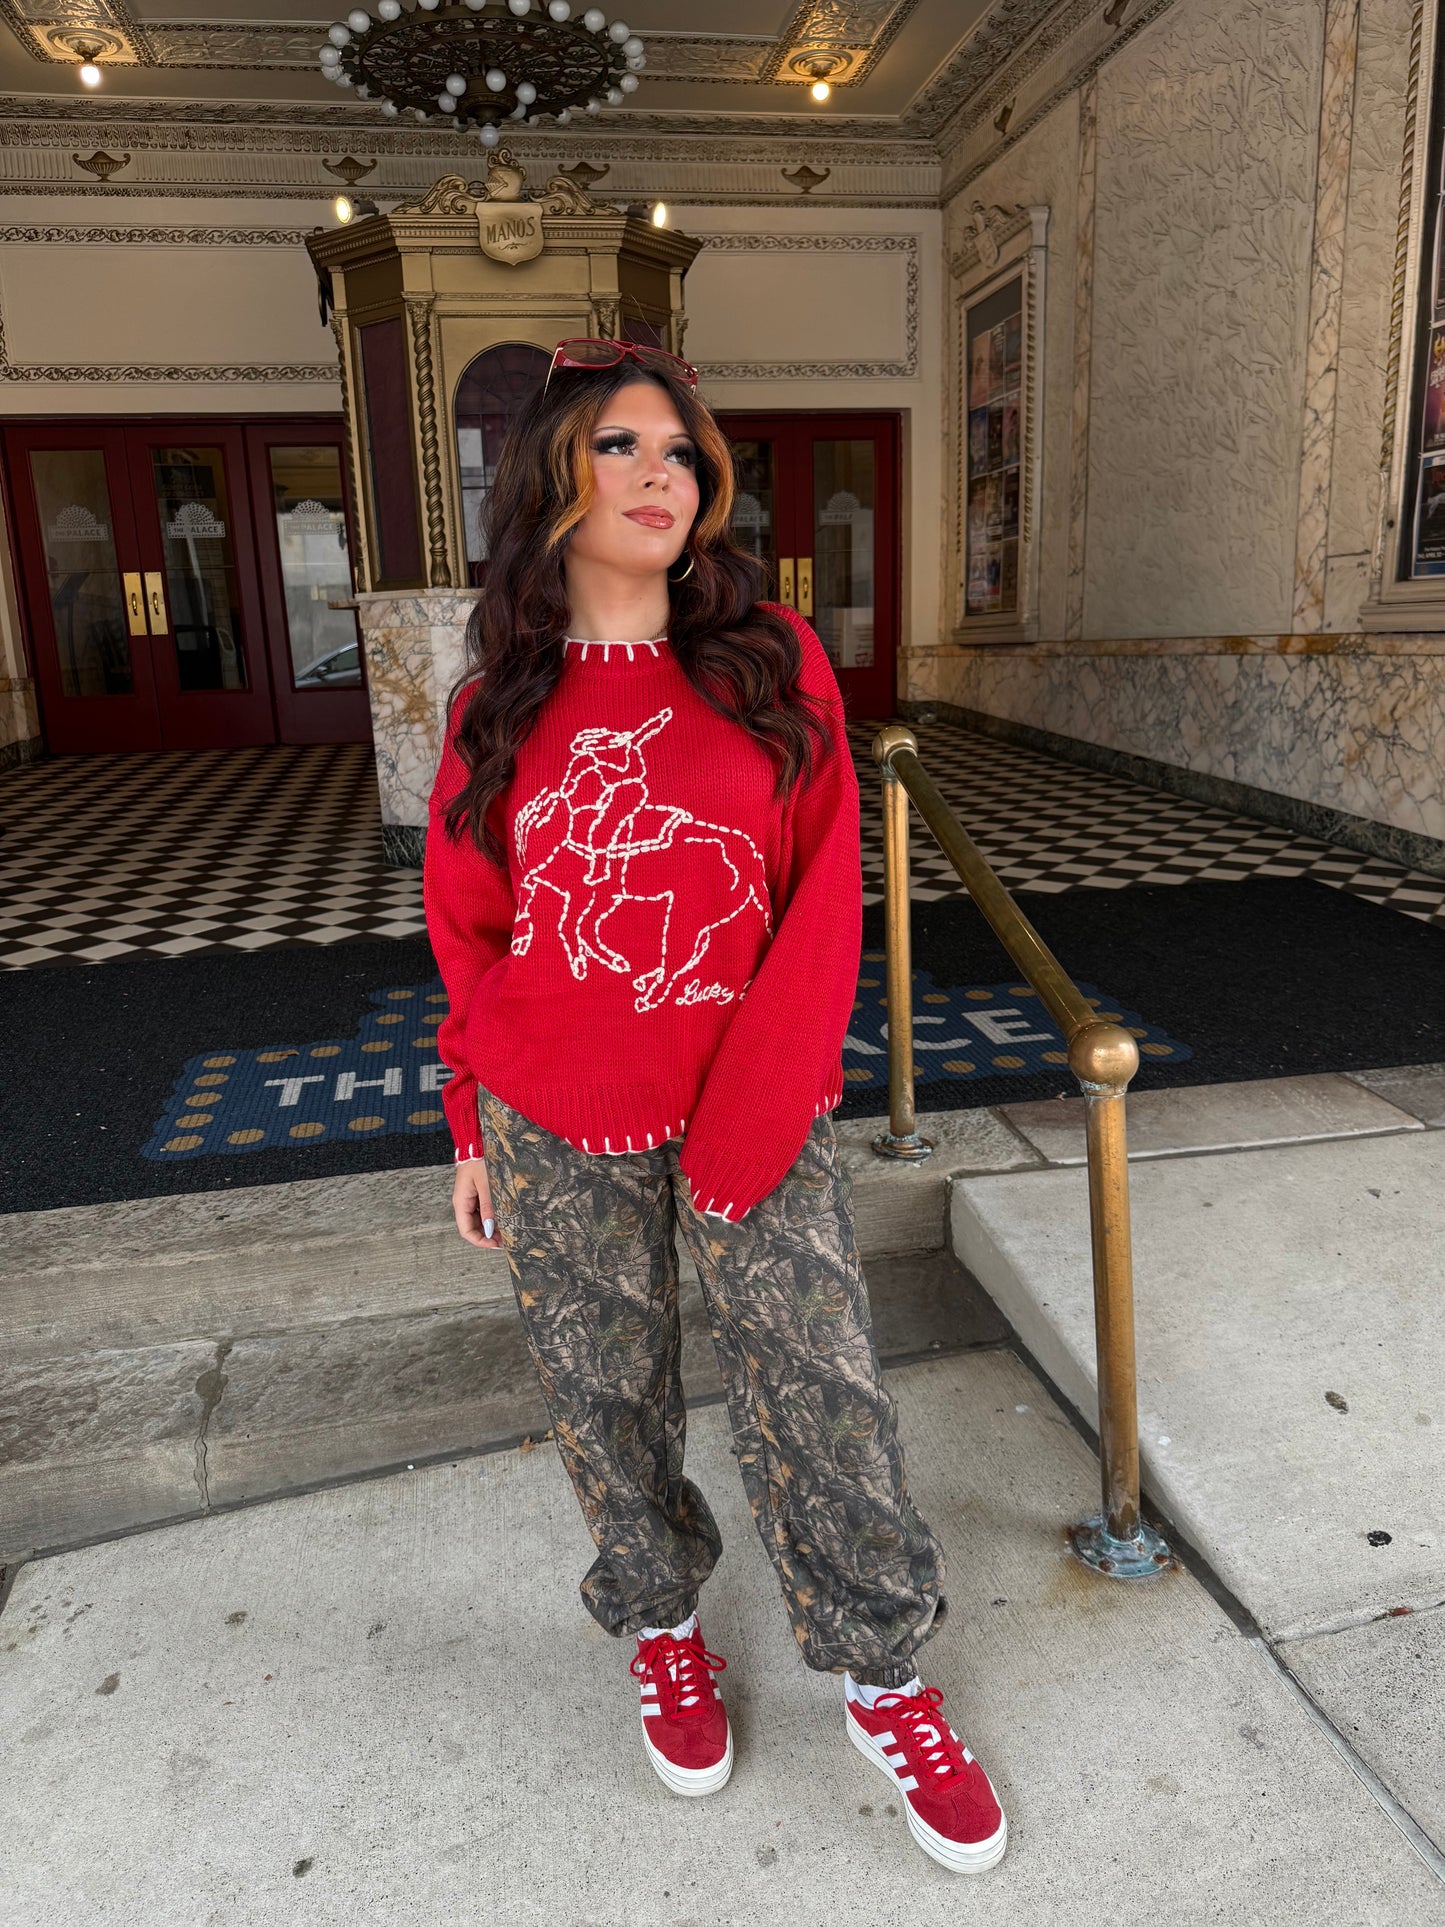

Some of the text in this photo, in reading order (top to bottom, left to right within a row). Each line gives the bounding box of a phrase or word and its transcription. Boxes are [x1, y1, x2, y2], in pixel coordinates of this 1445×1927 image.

[486, 216, 536, 244] MANOS
[675, 978, 735, 1005] Lucky
[264, 1063, 456, 1107] THE
